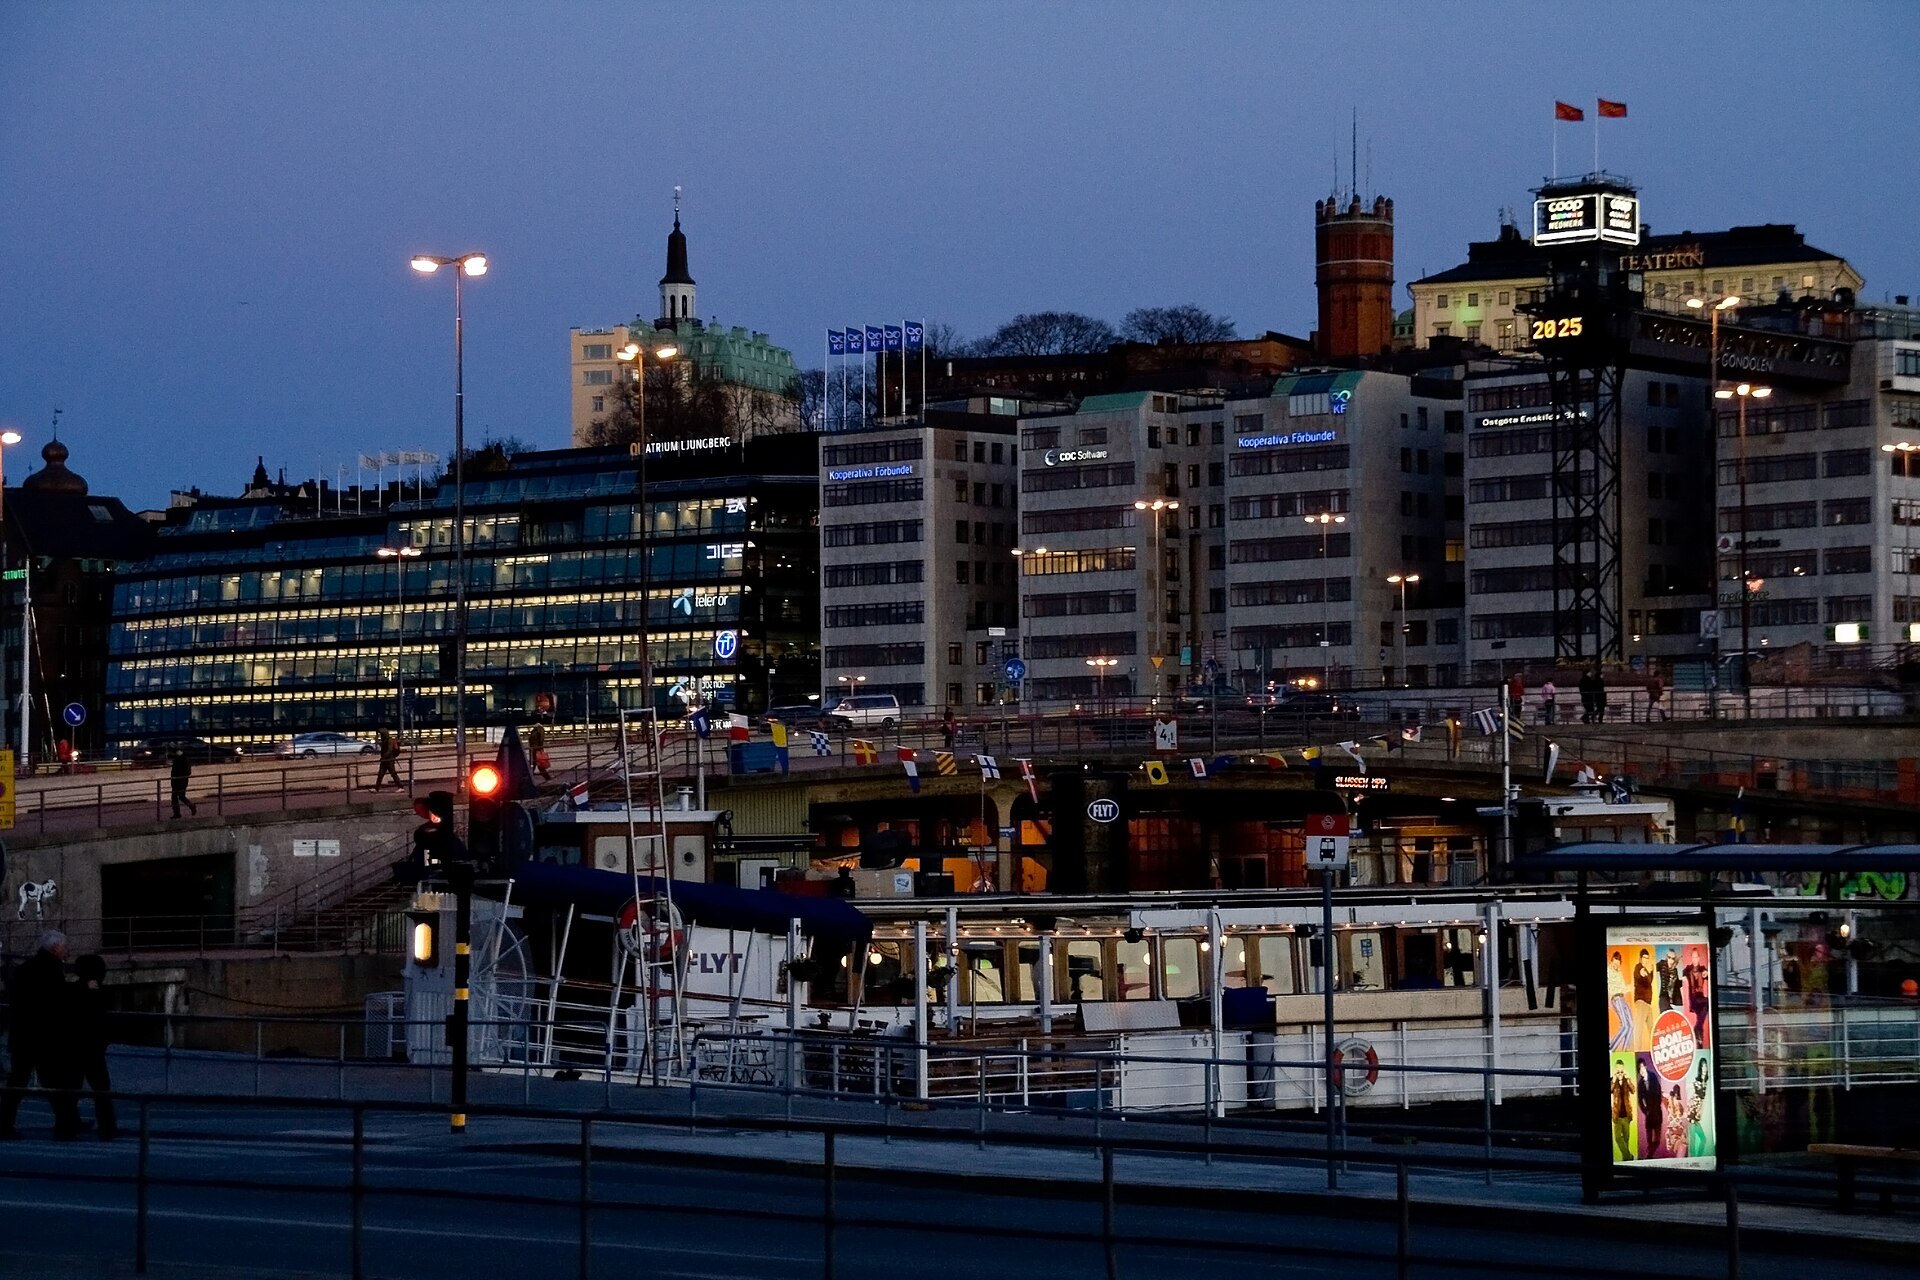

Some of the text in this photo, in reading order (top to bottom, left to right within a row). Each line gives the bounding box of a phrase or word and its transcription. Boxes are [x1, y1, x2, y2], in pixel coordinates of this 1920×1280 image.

[1548, 199, 1584, 212] coop
[1619, 251, 1704, 271] TEATERN
[870, 340, 881, 348] KF
[910, 335, 921, 343] KF
[1722, 353, 1775, 372] GONDOLEN
[1333, 404, 1347, 414] KF
[645, 441, 678, 454] ATRIUM
[680, 436, 731, 451] LJUNGBERG
[1238, 430, 1336, 448] Kooperativa Förbundet
[1060, 450, 1107, 461] CDC Software
[829, 465, 913, 481] Kooperativa Förbundet
[725, 499, 746, 513] EA
[1093, 804, 1113, 817] FLYT
[687, 952, 743, 974] FLYT
